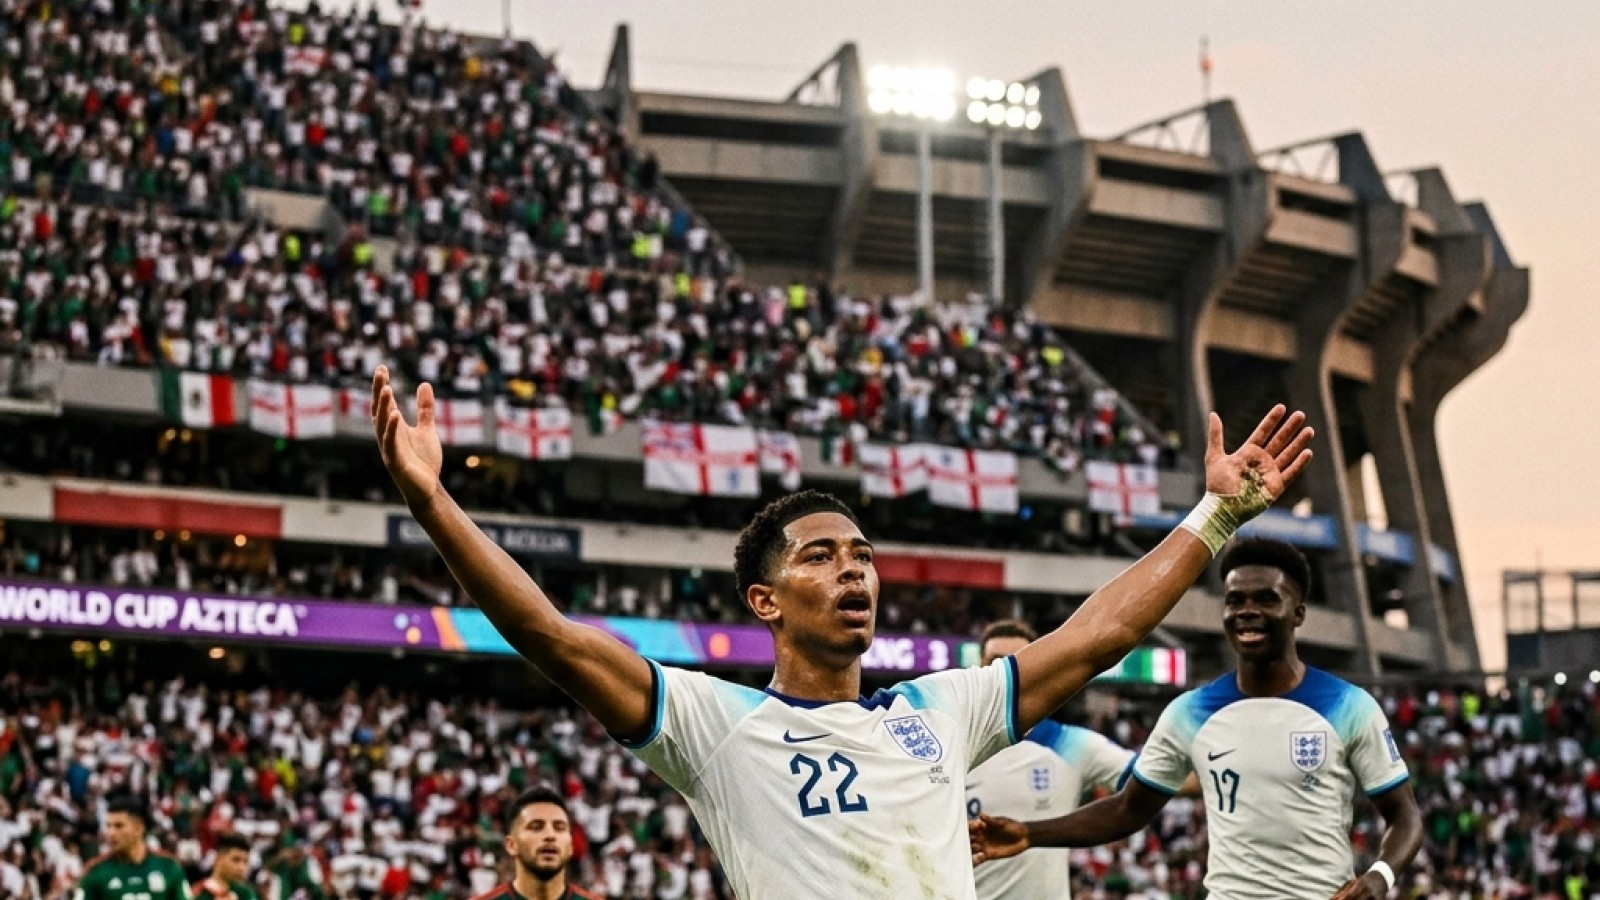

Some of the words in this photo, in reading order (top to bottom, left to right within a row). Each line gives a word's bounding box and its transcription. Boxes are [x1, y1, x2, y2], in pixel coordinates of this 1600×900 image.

[0, 586, 111, 625] WORLD
[114, 593, 178, 629] CUP
[928, 640, 949, 670] 3
[789, 752, 869, 817] 22
[1209, 769, 1240, 813] 17
